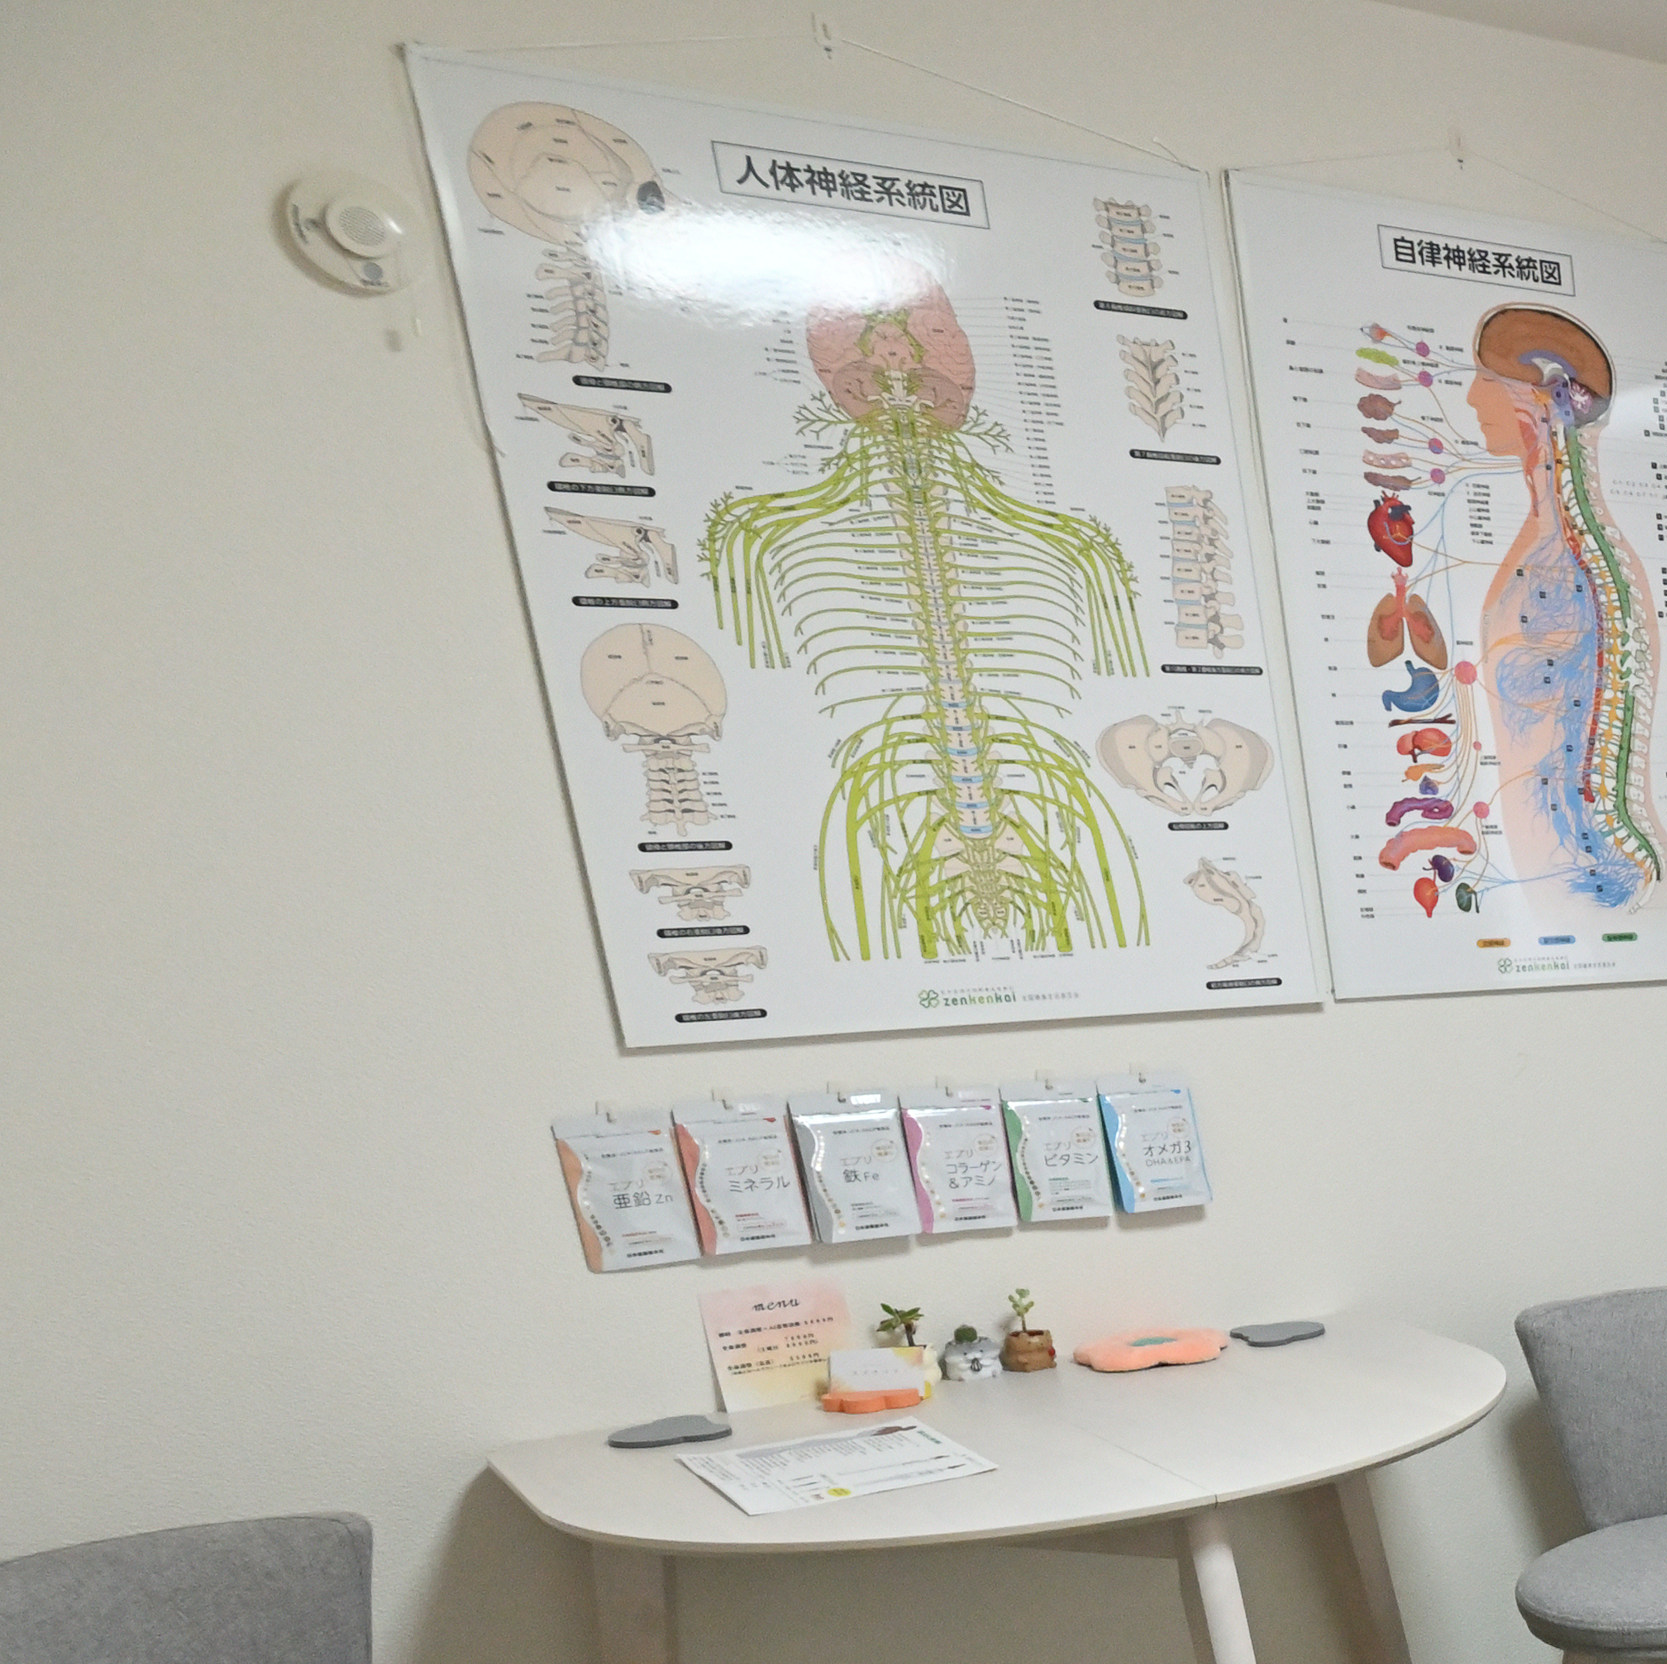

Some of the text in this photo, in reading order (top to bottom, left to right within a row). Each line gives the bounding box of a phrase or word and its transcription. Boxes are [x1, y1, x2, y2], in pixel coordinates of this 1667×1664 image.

[737, 155, 970, 216] 人体神経系統図
[1393, 236, 1562, 285] 自律神経系統図
[943, 992, 1016, 1007] zenkenkai
[1045, 1153, 1098, 1167] ビタミン
[729, 1175, 790, 1193] ミネラル
[613, 1191, 651, 1209] 亜鉛
[752, 1298, 800, 1312] menu
